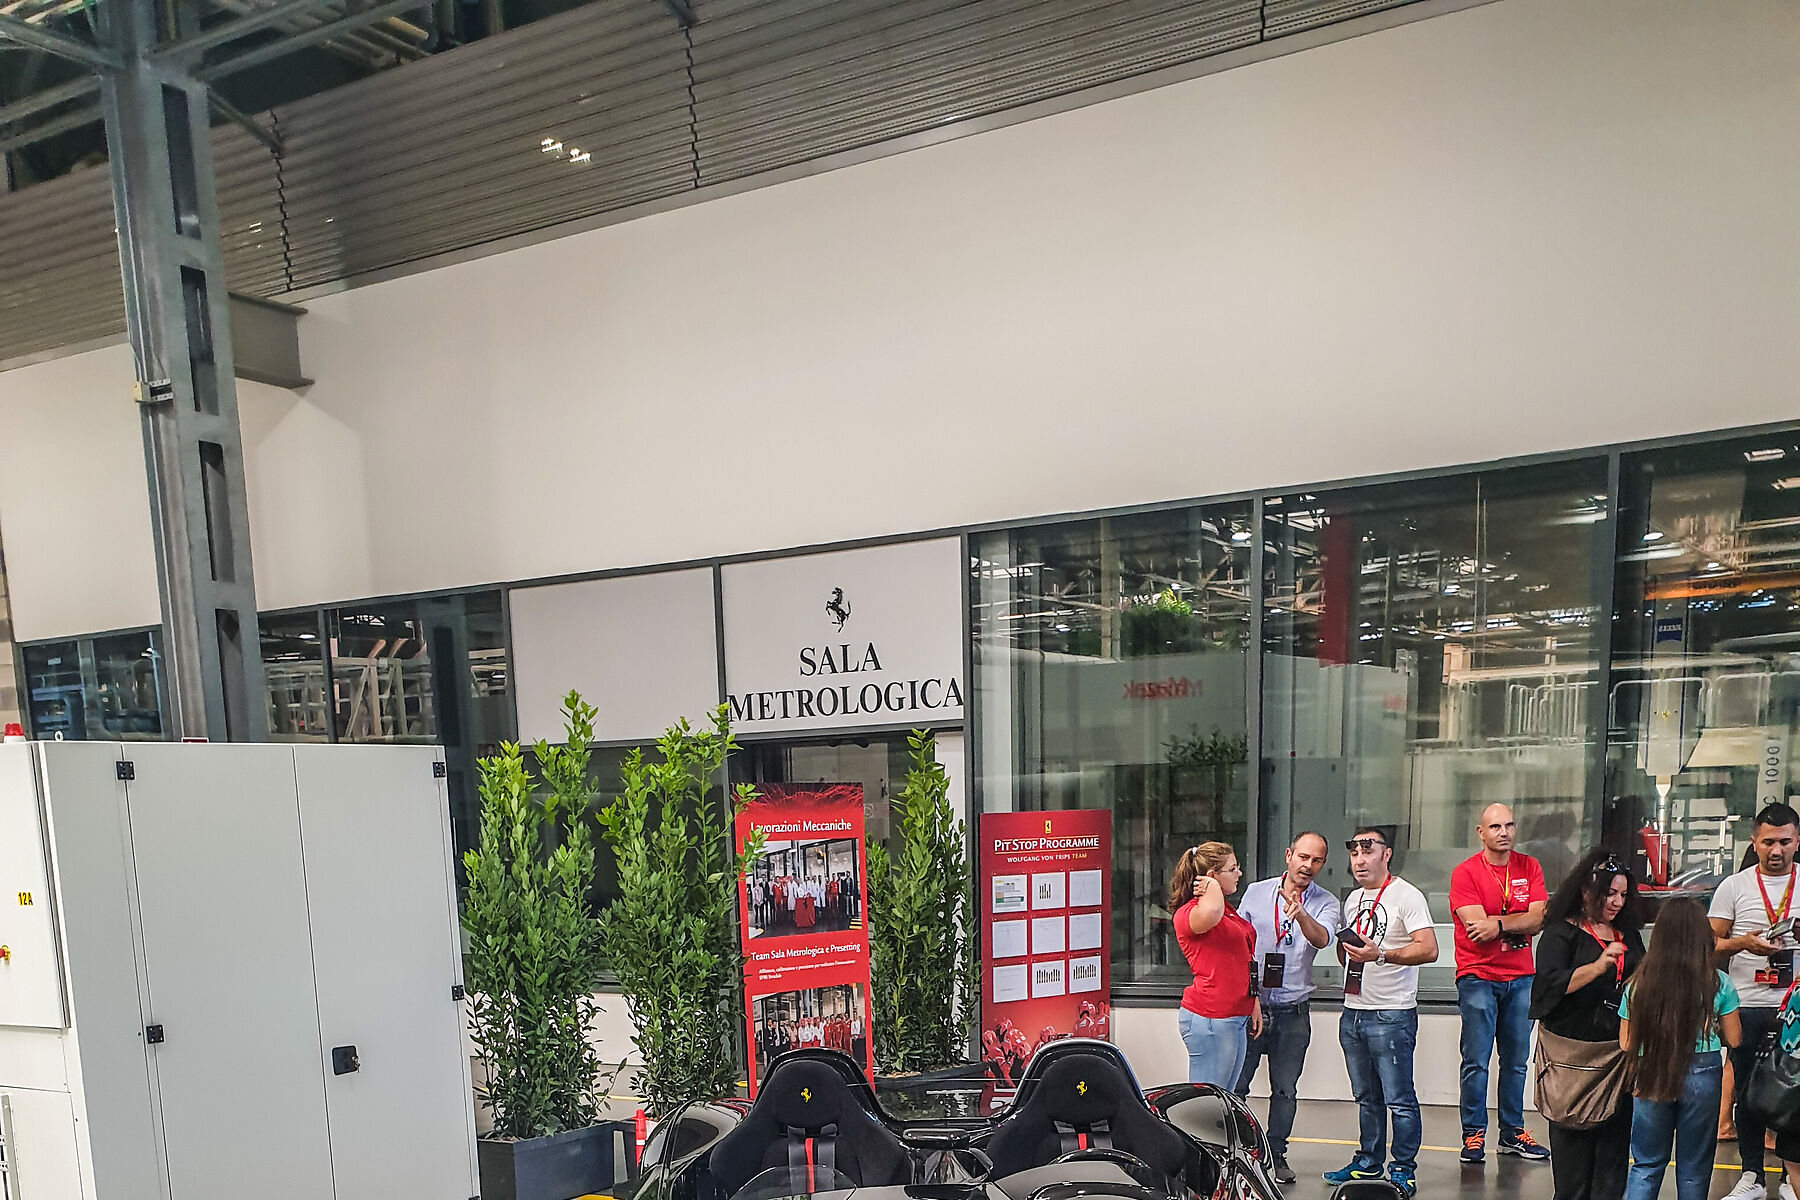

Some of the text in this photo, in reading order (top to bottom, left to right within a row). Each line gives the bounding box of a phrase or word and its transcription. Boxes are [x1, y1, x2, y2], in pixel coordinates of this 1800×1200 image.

[799, 641, 882, 677] SALA
[727, 677, 964, 723] METROLOGICA
[802, 818, 852, 832] Meccaniche
[994, 836, 1100, 851] PIT STOP PROGRAMME
[1007, 855, 1040, 863] WOLFGANG
[18, 891, 33, 906] 12A
[750, 951, 770, 961] Team
[770, 949, 786, 959] Sala
[786, 945, 825, 958] Metrologica
